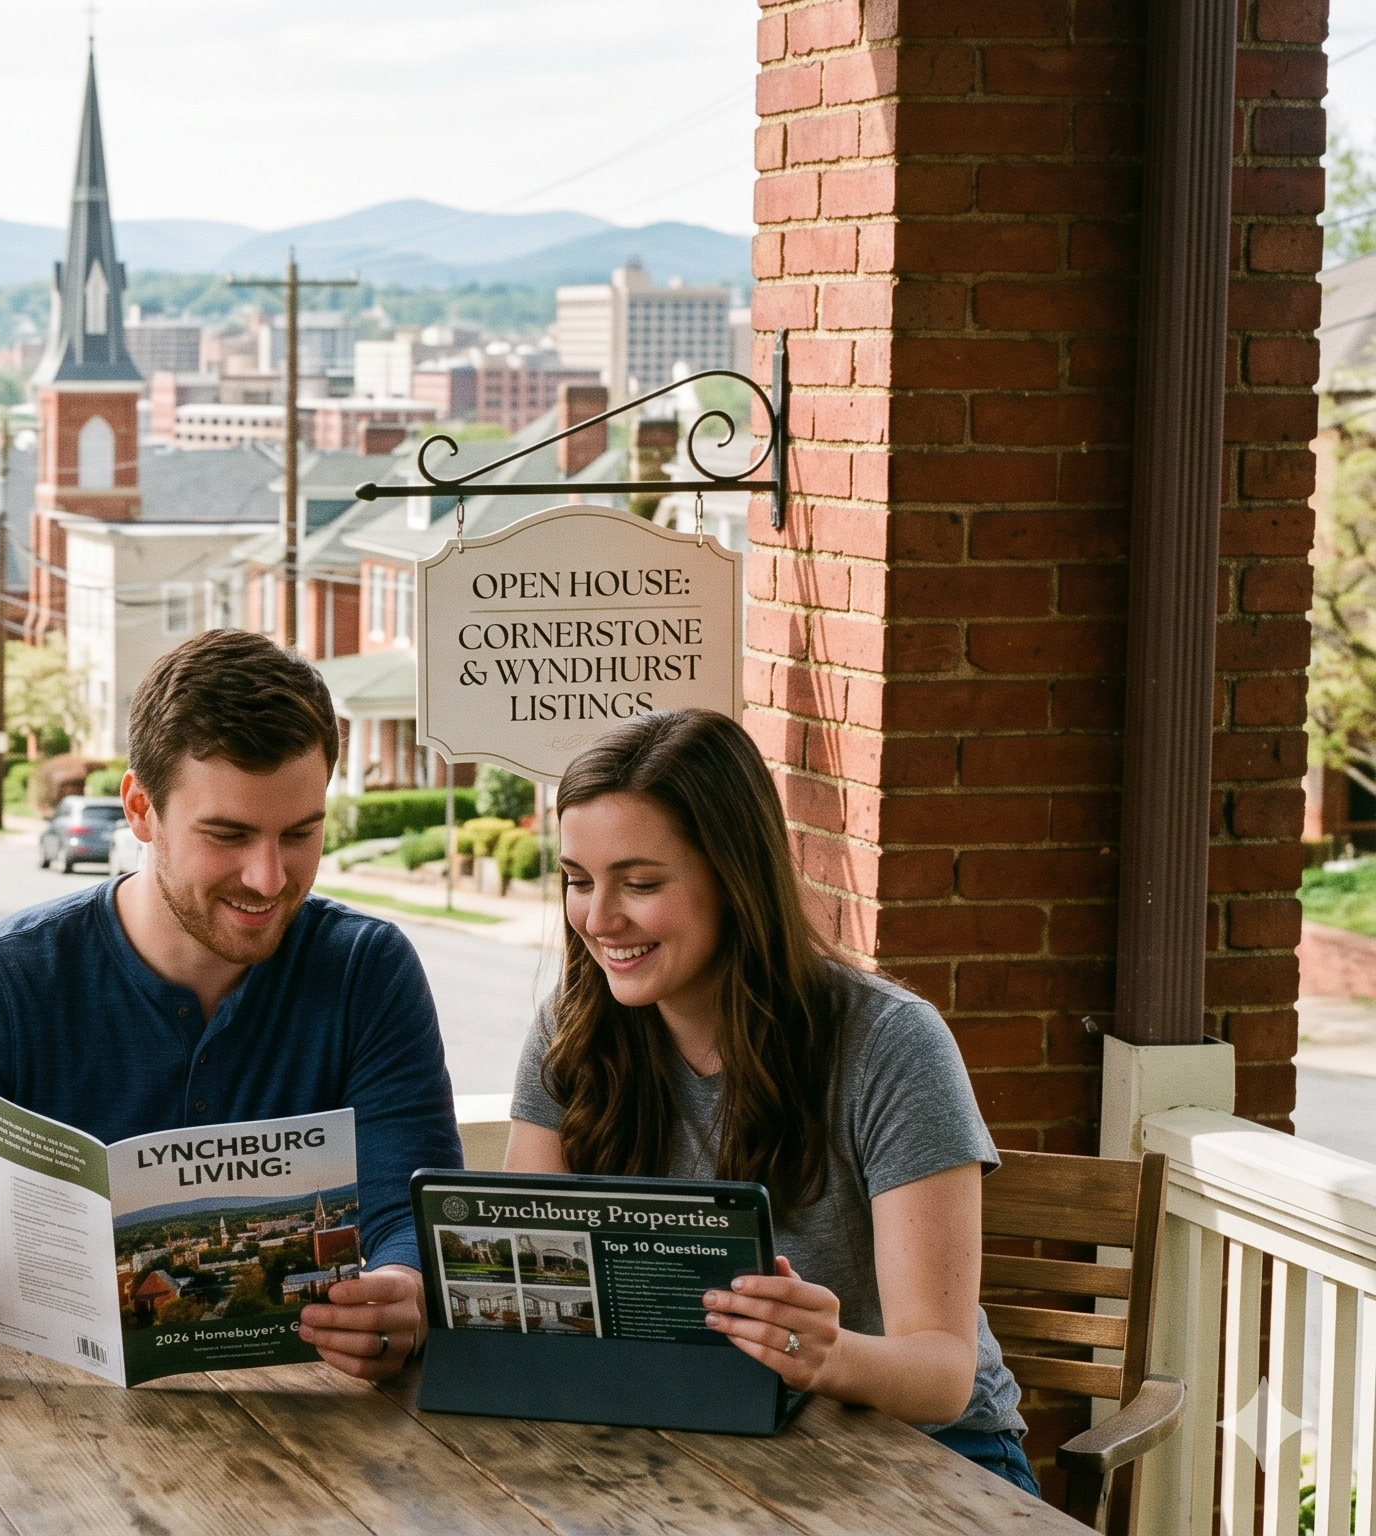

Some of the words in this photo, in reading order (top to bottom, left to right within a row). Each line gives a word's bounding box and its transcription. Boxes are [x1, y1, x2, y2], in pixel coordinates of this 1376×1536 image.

[472, 571, 560, 599] OPEN
[570, 568, 691, 598] HOUSE:
[458, 618, 703, 650] CORNERSTONE
[459, 660, 488, 686] &
[495, 654, 702, 685] WYNDHURST
[510, 691, 654, 721] LISTINGS
[137, 1127, 326, 1169] LYNCHBURG
[178, 1156, 292, 1187] LIVING:
[476, 1200, 602, 1226] Lynchburg
[607, 1205, 729, 1230] Properties
[601, 1240, 629, 1254] Top
[633, 1241, 649, 1253] 10
[653, 1242, 728, 1256] Questions
[156, 1332, 190, 1346] 2026
[195, 1324, 286, 1341] Homebuyer's
